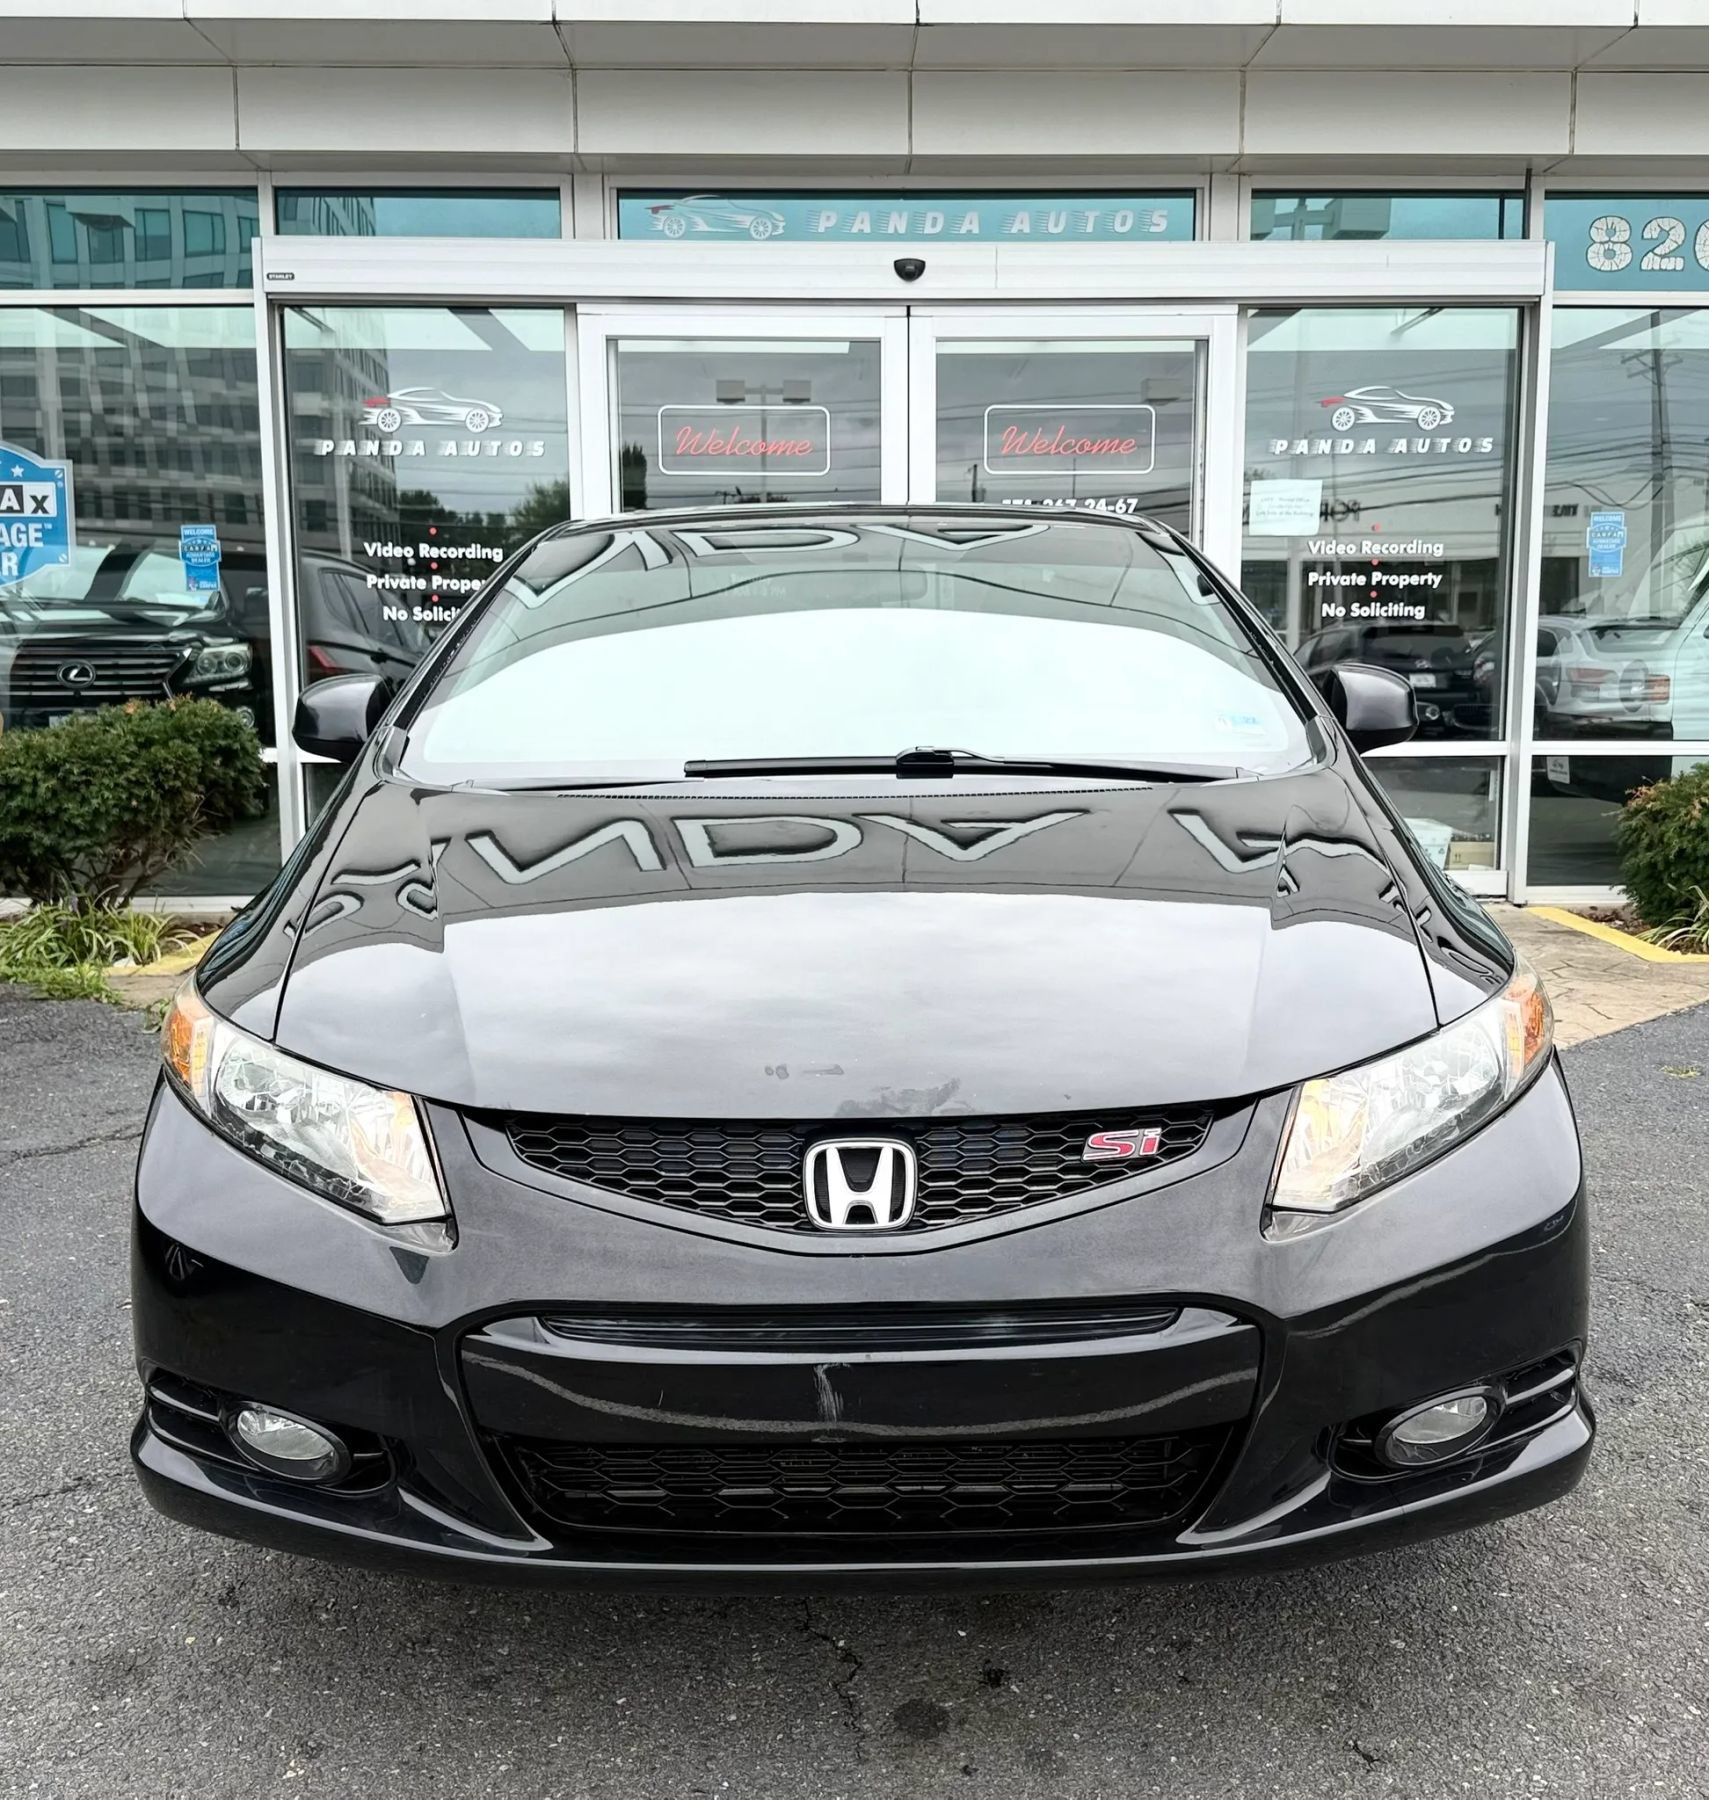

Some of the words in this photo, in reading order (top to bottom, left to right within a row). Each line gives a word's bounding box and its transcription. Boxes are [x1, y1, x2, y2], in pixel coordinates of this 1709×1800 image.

[803, 210, 980, 234] PANDA
[1002, 209, 1168, 234] AUTOS
[315, 440, 426, 456] PANDA
[438, 440, 545, 456] AUTOS
[675, 425, 814, 457] Welcome
[1000, 425, 1137, 456] Welcome
[1270, 439, 1376, 455] PANDA
[1388, 437, 1494, 454] AUTOS
[184, 528, 214, 536] WELCOME
[364, 543, 414, 558] Video
[419, 543, 504, 562] Recording
[1309, 541, 1356, 555] Video
[1361, 540, 1444, 557] Recording
[366, 575, 427, 590] Private
[1308, 572, 1366, 587] Private
[1371, 572, 1442, 589] Property
[383, 606, 408, 621] No
[413, 606, 461, 621] Solici
[1321, 603, 1346, 618] No
[1350, 603, 1426, 620] Soliciting
[1083, 1128, 1161, 1160] Si
